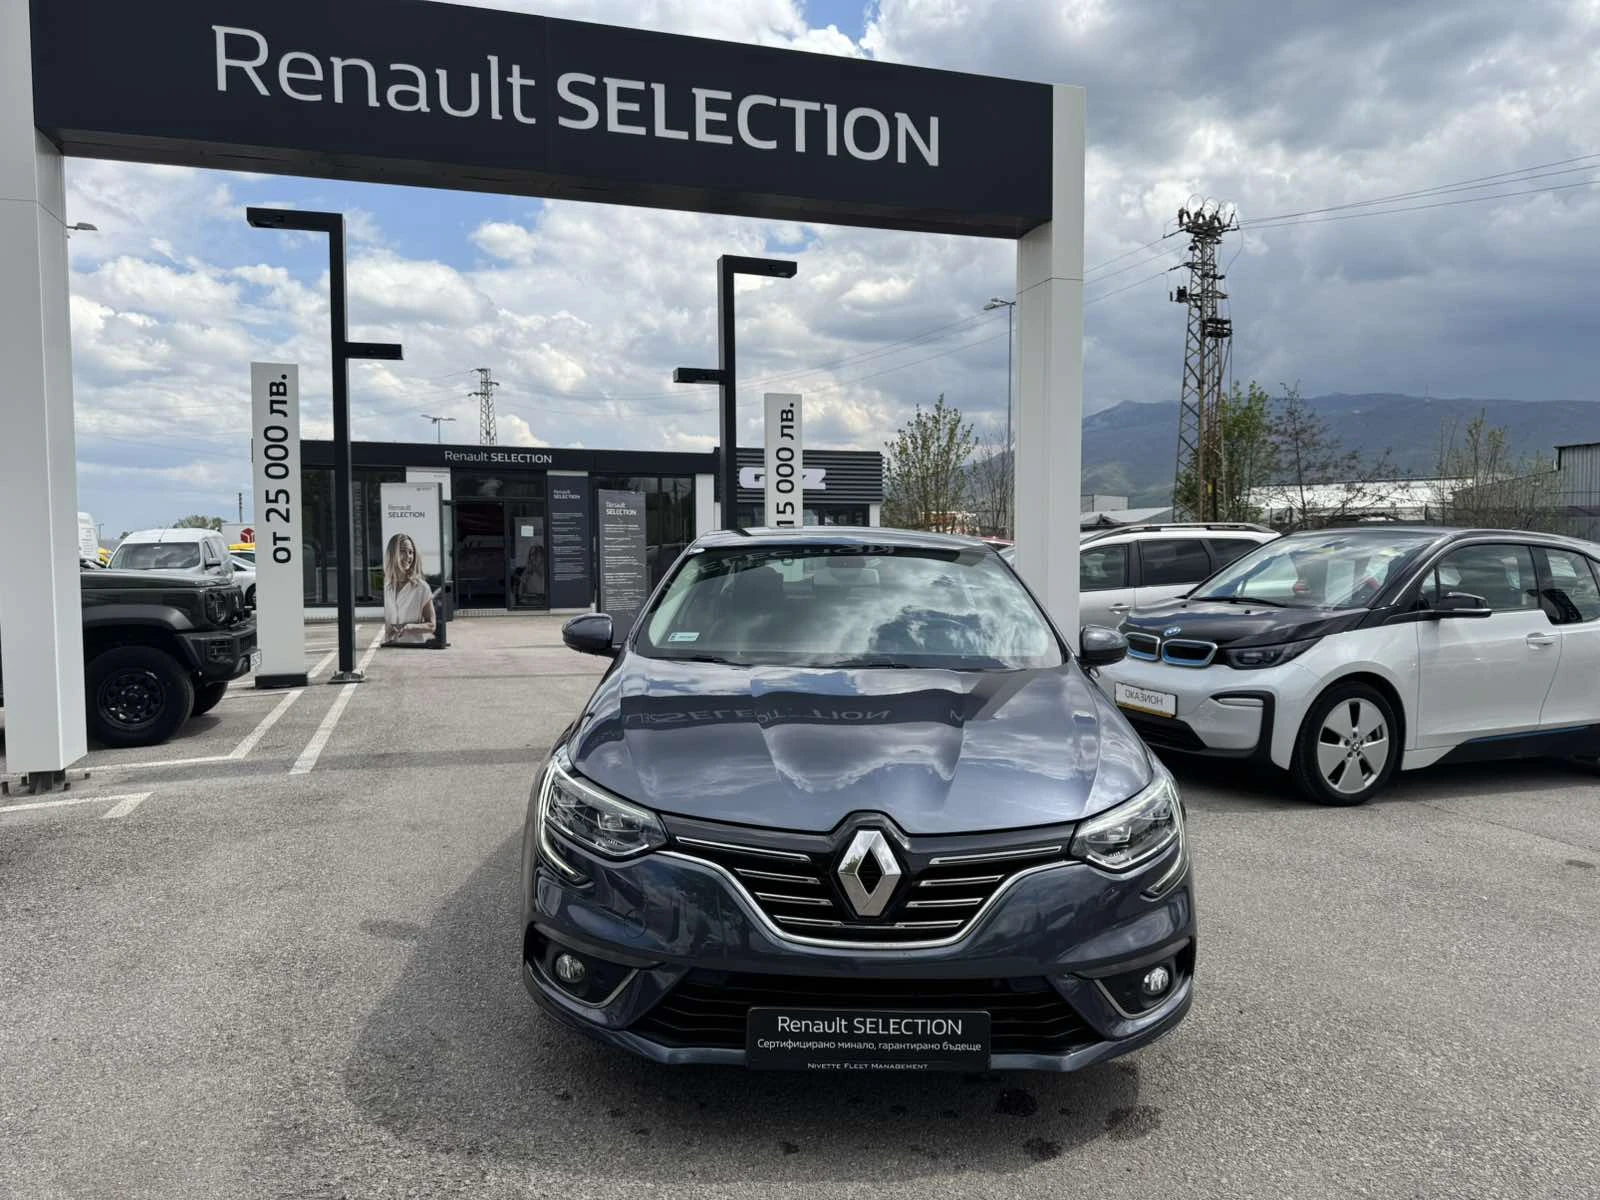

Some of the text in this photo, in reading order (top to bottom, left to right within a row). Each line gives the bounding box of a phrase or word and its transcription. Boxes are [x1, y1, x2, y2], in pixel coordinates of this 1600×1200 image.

[211, 25, 939, 167] Renault SELECTION
[263, 374, 292, 564] от 25 000 лв.
[444, 450, 552, 463] Renault SELECTION
[776, 402, 795, 527] 15 000 лв.
[757, 1039, 982, 1052] Сертифицирано минало, гарантирано бъдеще
[777, 1016, 963, 1036] Renault SELECTION
